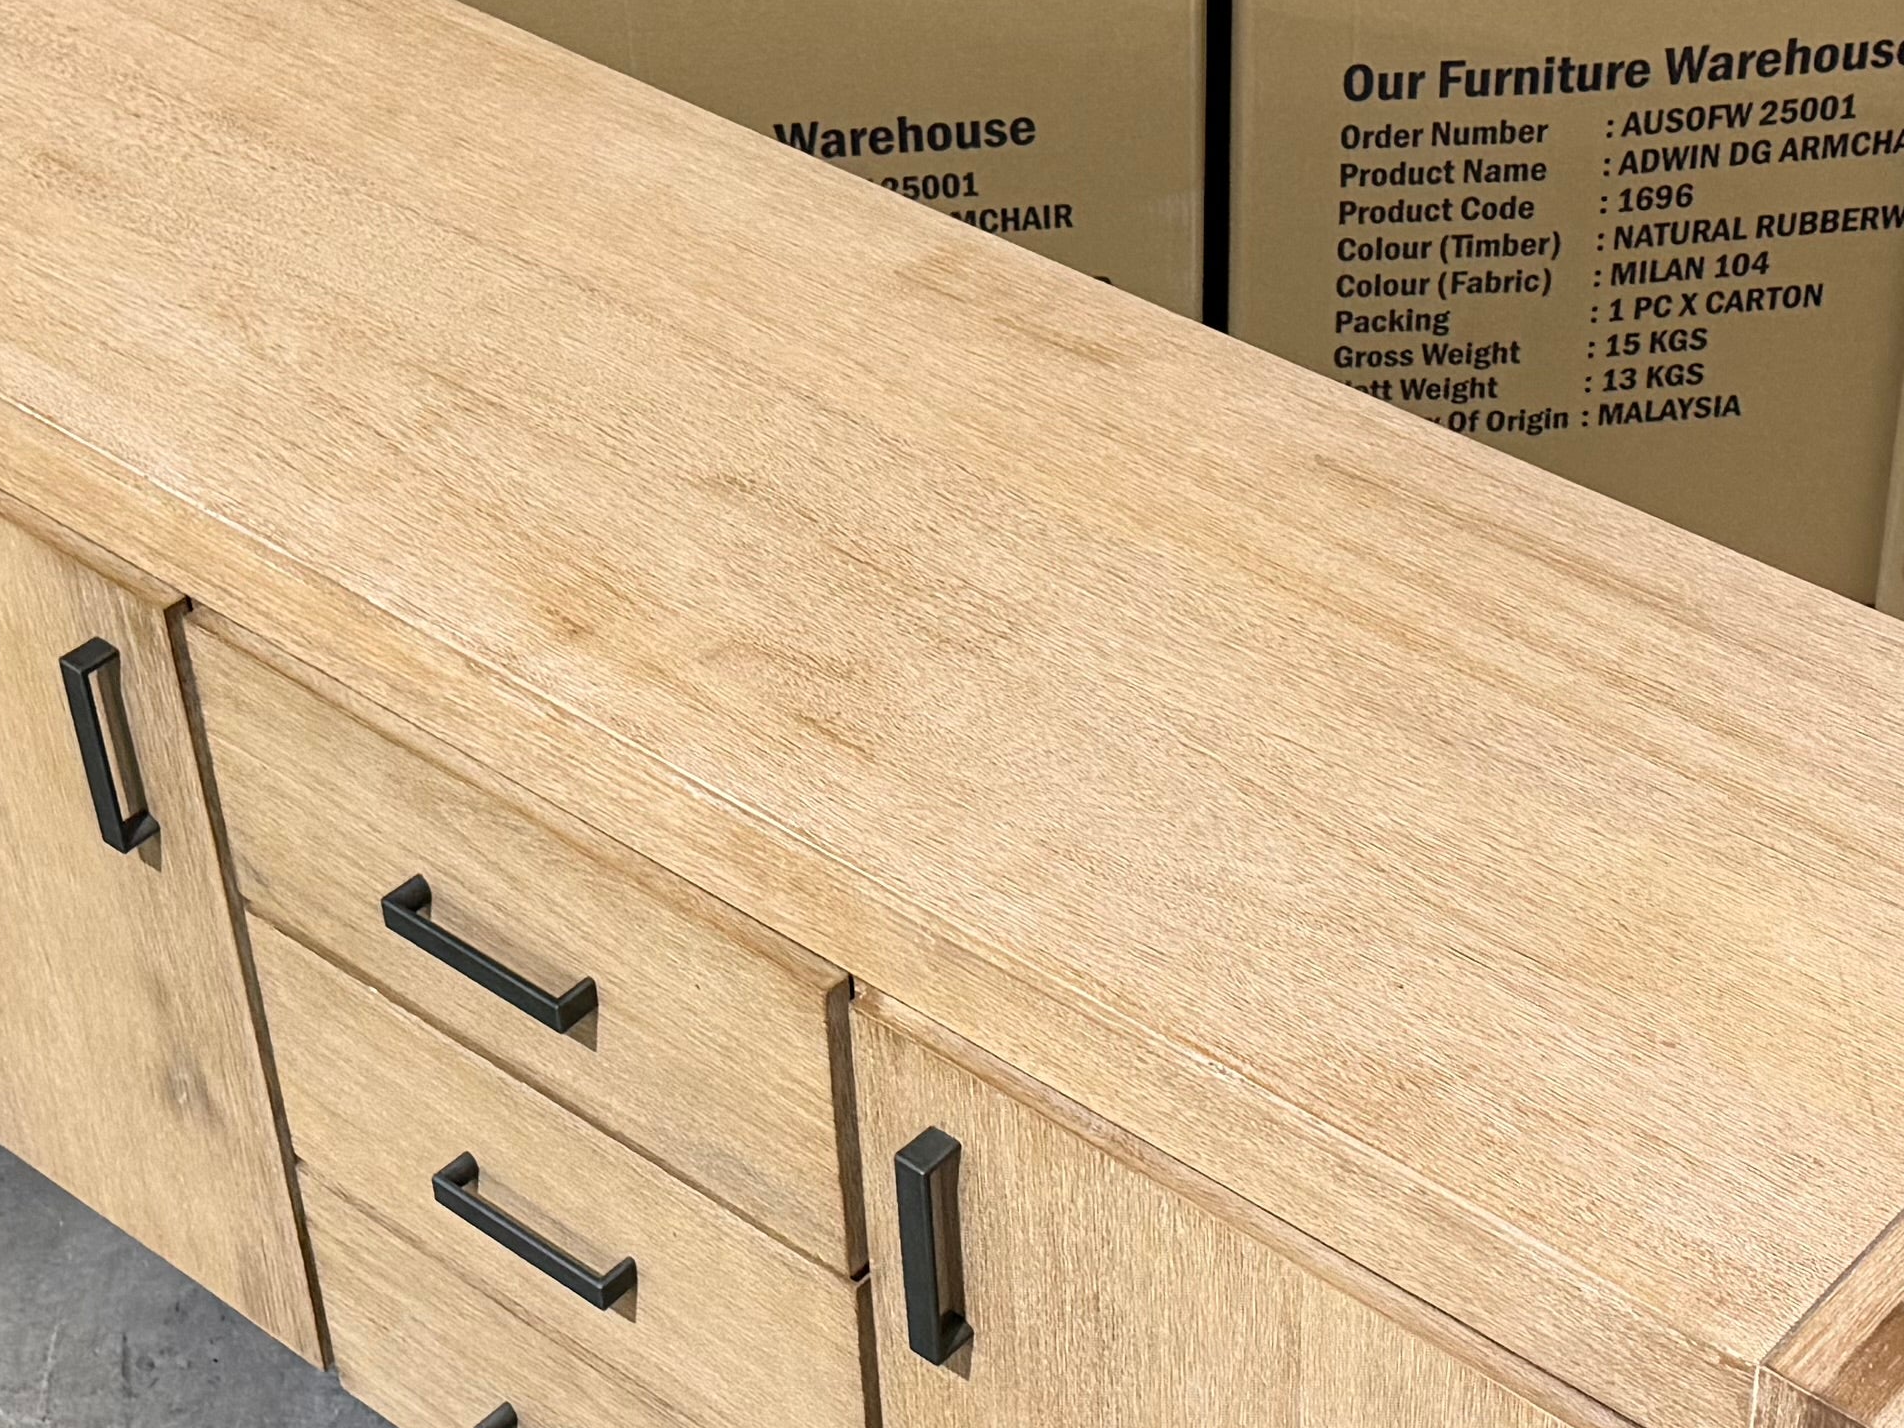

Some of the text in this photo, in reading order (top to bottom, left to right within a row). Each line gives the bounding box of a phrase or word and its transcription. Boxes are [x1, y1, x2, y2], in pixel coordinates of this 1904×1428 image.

[1342, 63, 1427, 103] Our
[1438, 55, 1651, 99] Furniture
[773, 114, 1037, 158] Warehouse
[1340, 93, 1857, 150] Order Number AUSOFW 25001
[949, 203, 1075, 234] MCHAIR
[1338, 182, 1694, 226] Product Code 1696
[1337, 236, 1433, 262] Colour
[1439, 230, 1562, 265] (Timber)
[1613, 216, 1748, 251] NATURAL
[1334, 282, 1824, 337] Packing 1 PC X CARTON
[1447, 394, 1742, 437] Of Origin MALAYSIA
